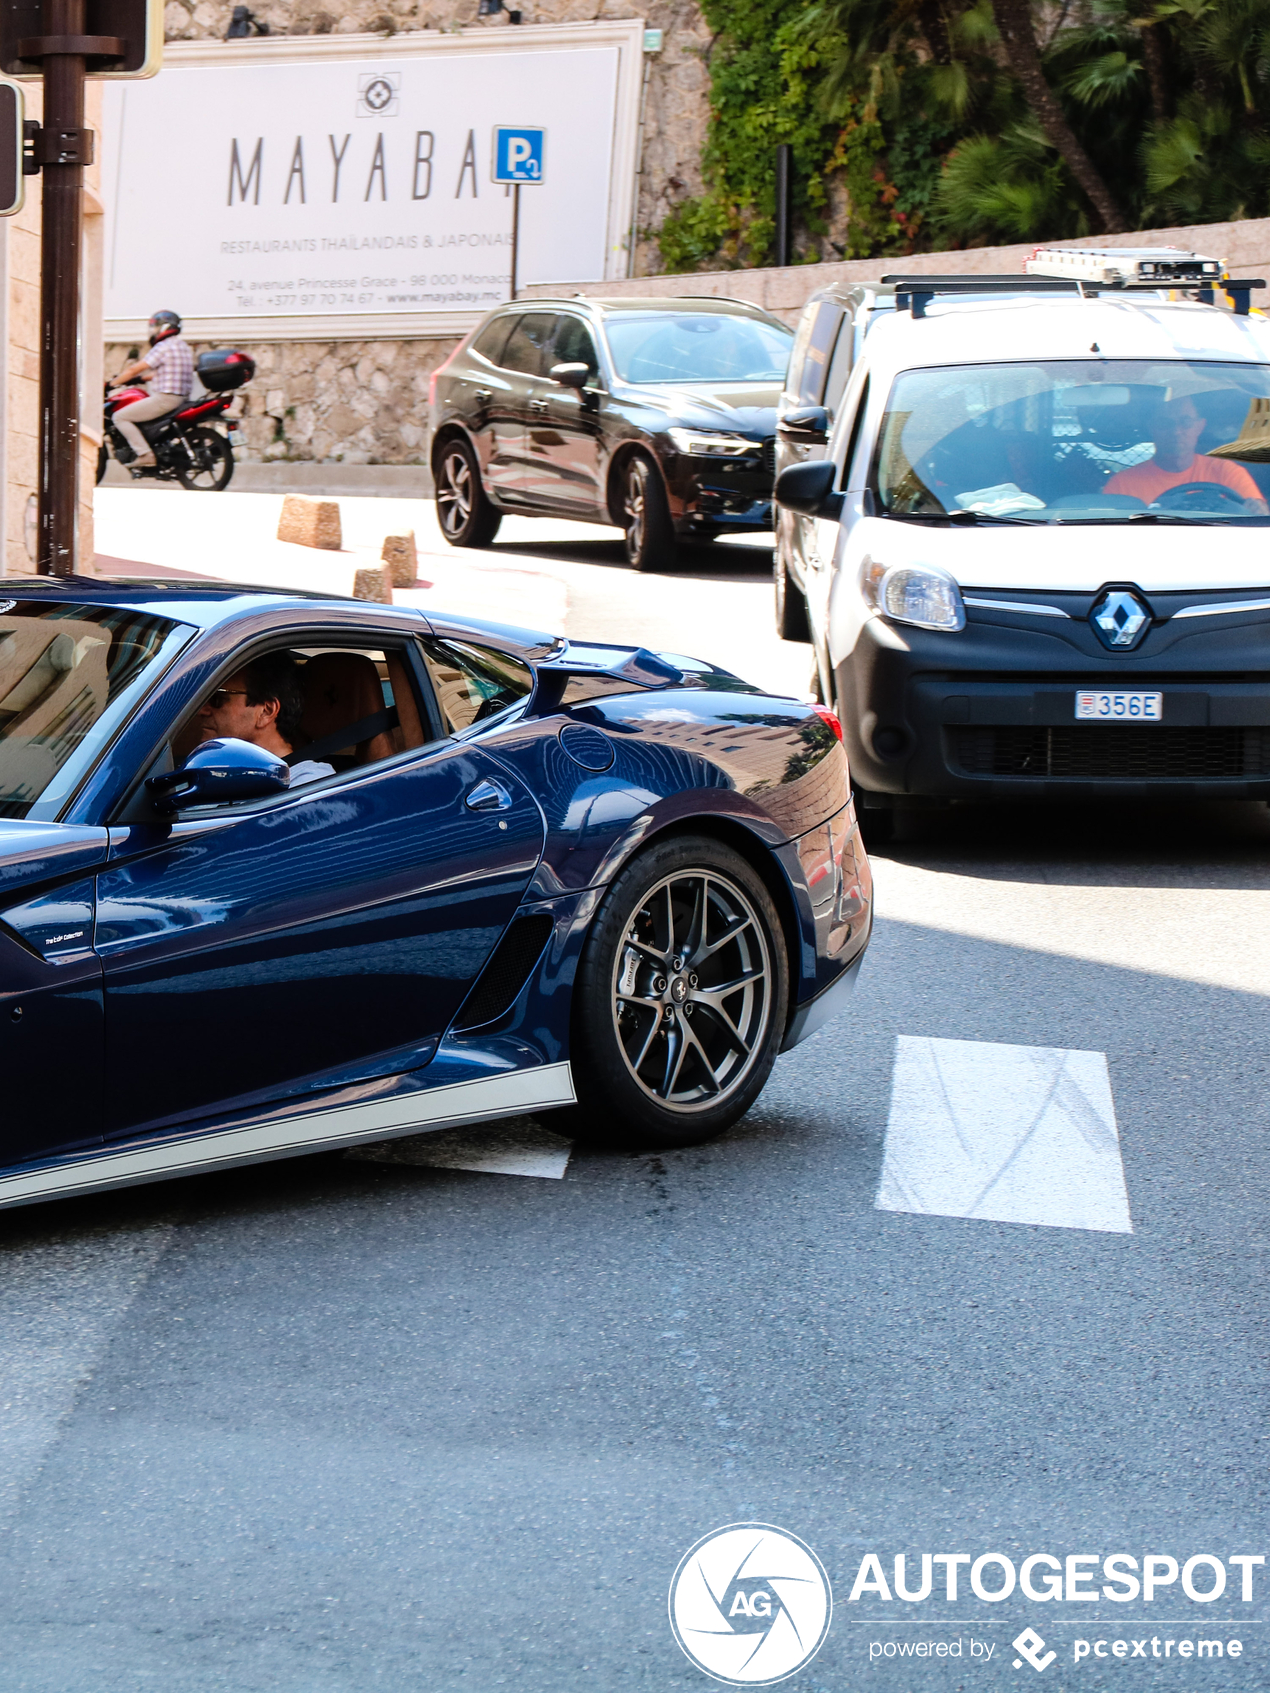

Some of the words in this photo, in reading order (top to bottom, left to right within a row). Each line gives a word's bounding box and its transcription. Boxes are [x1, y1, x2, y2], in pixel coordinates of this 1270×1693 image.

[507, 137, 532, 172] P
[227, 127, 509, 207] MAYABA
[220, 239, 317, 254] RESTAURANTS
[320, 234, 418, 252] THAÏLANDAIS
[423, 235, 433, 248] &
[250, 280, 294, 291] avenue
[298, 278, 357, 289] Princesse
[360, 276, 398, 288] Grace
[410, 275, 427, 286] 98
[431, 274, 458, 286] 000
[267, 294, 297, 306] +377
[300, 293, 317, 306] 97
[319, 293, 336, 305] 70
[339, 293, 355, 305] 74
[358, 292, 374, 304] 67
[387, 291, 502, 304] www.mayabay.mc
[1098, 695, 1156, 716] 356E
